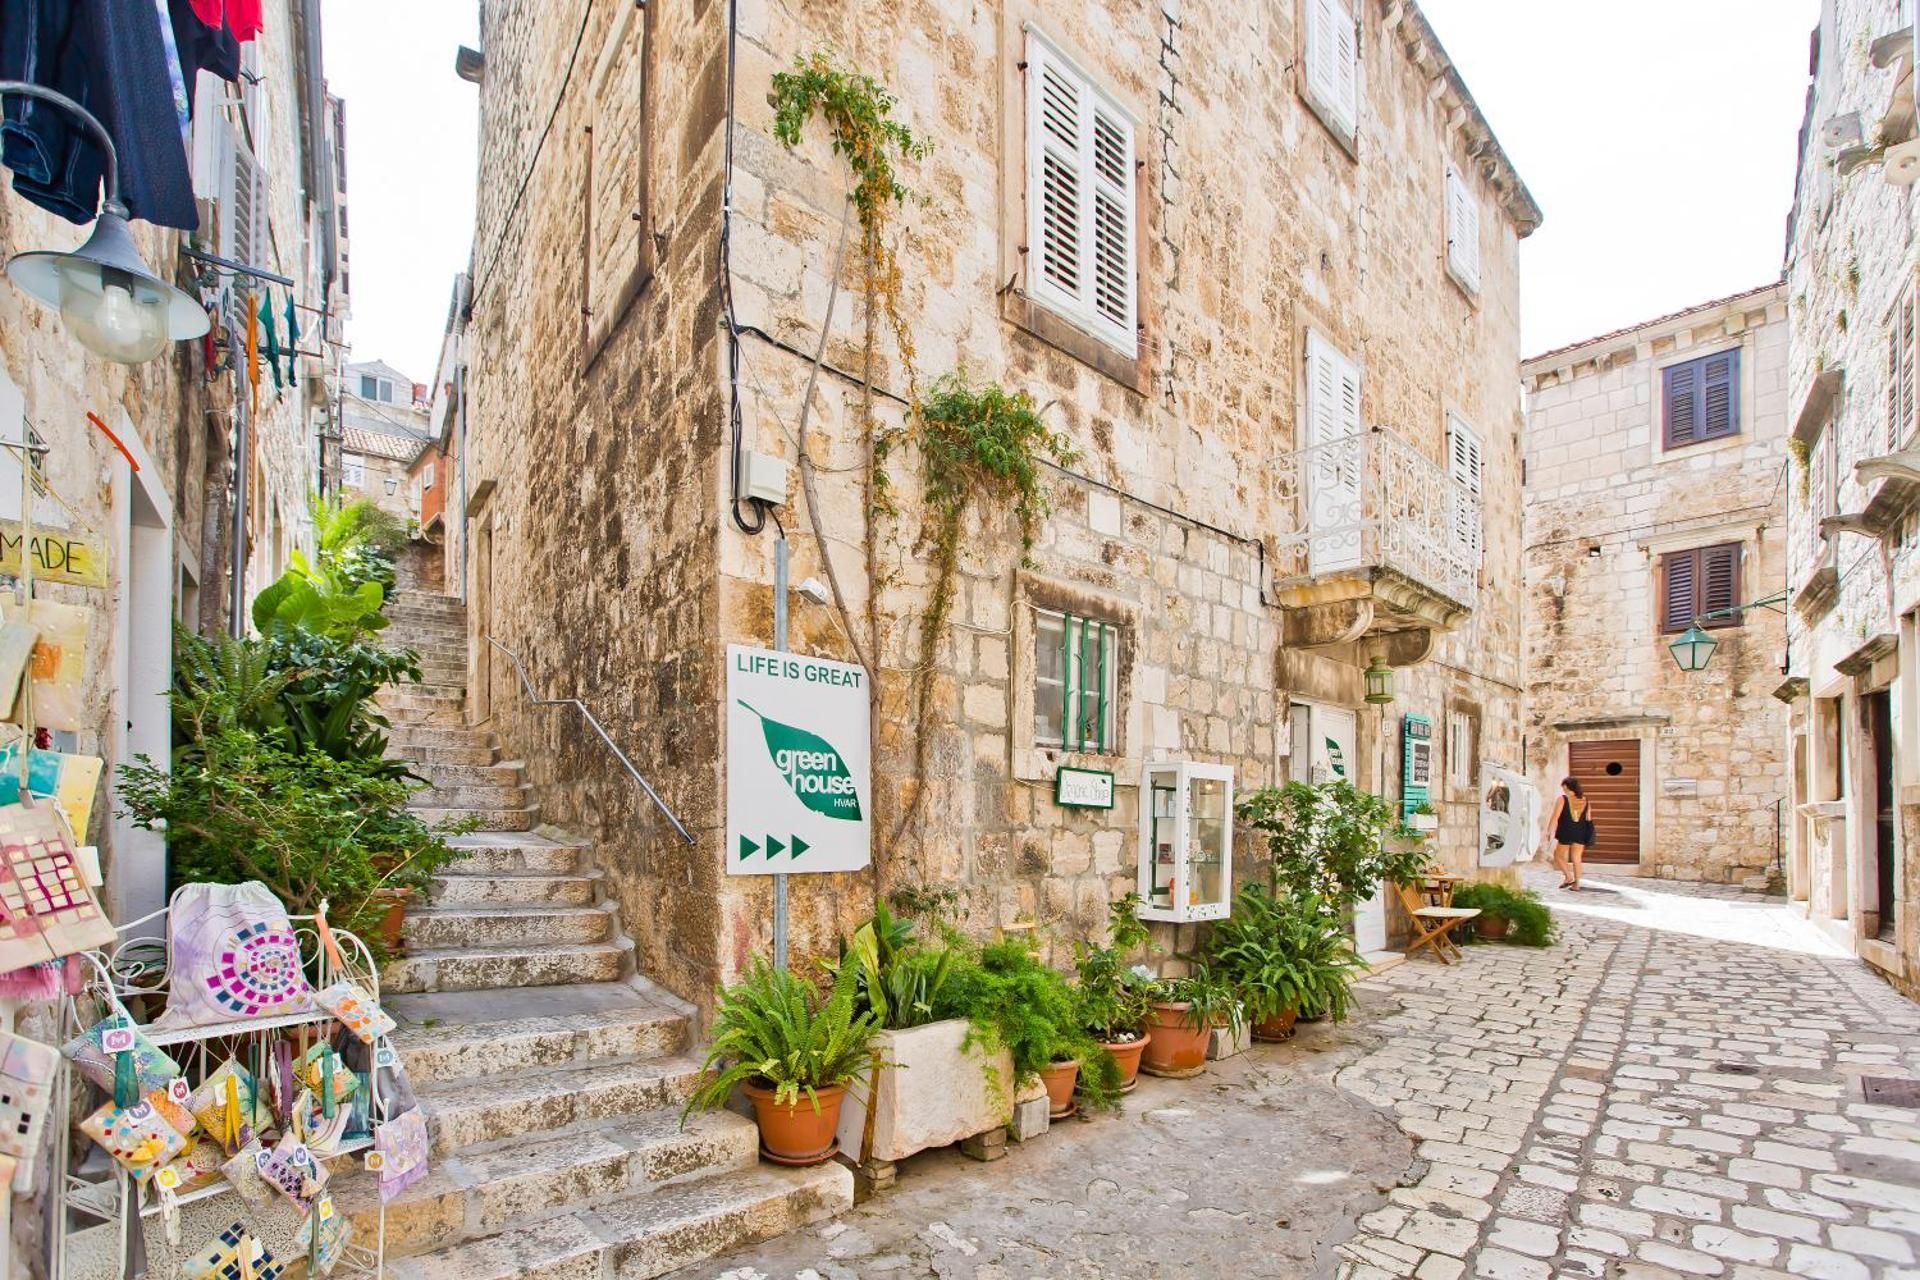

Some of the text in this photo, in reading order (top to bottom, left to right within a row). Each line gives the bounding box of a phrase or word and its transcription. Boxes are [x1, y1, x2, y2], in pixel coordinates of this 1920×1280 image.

[737, 653, 862, 688] LIFE IS GREAT
[776, 749, 837, 775] green
[791, 768, 856, 795] house
[833, 798, 857, 808] HVAR
[111, 1034, 127, 1046] M
[133, 1104, 148, 1117] M
